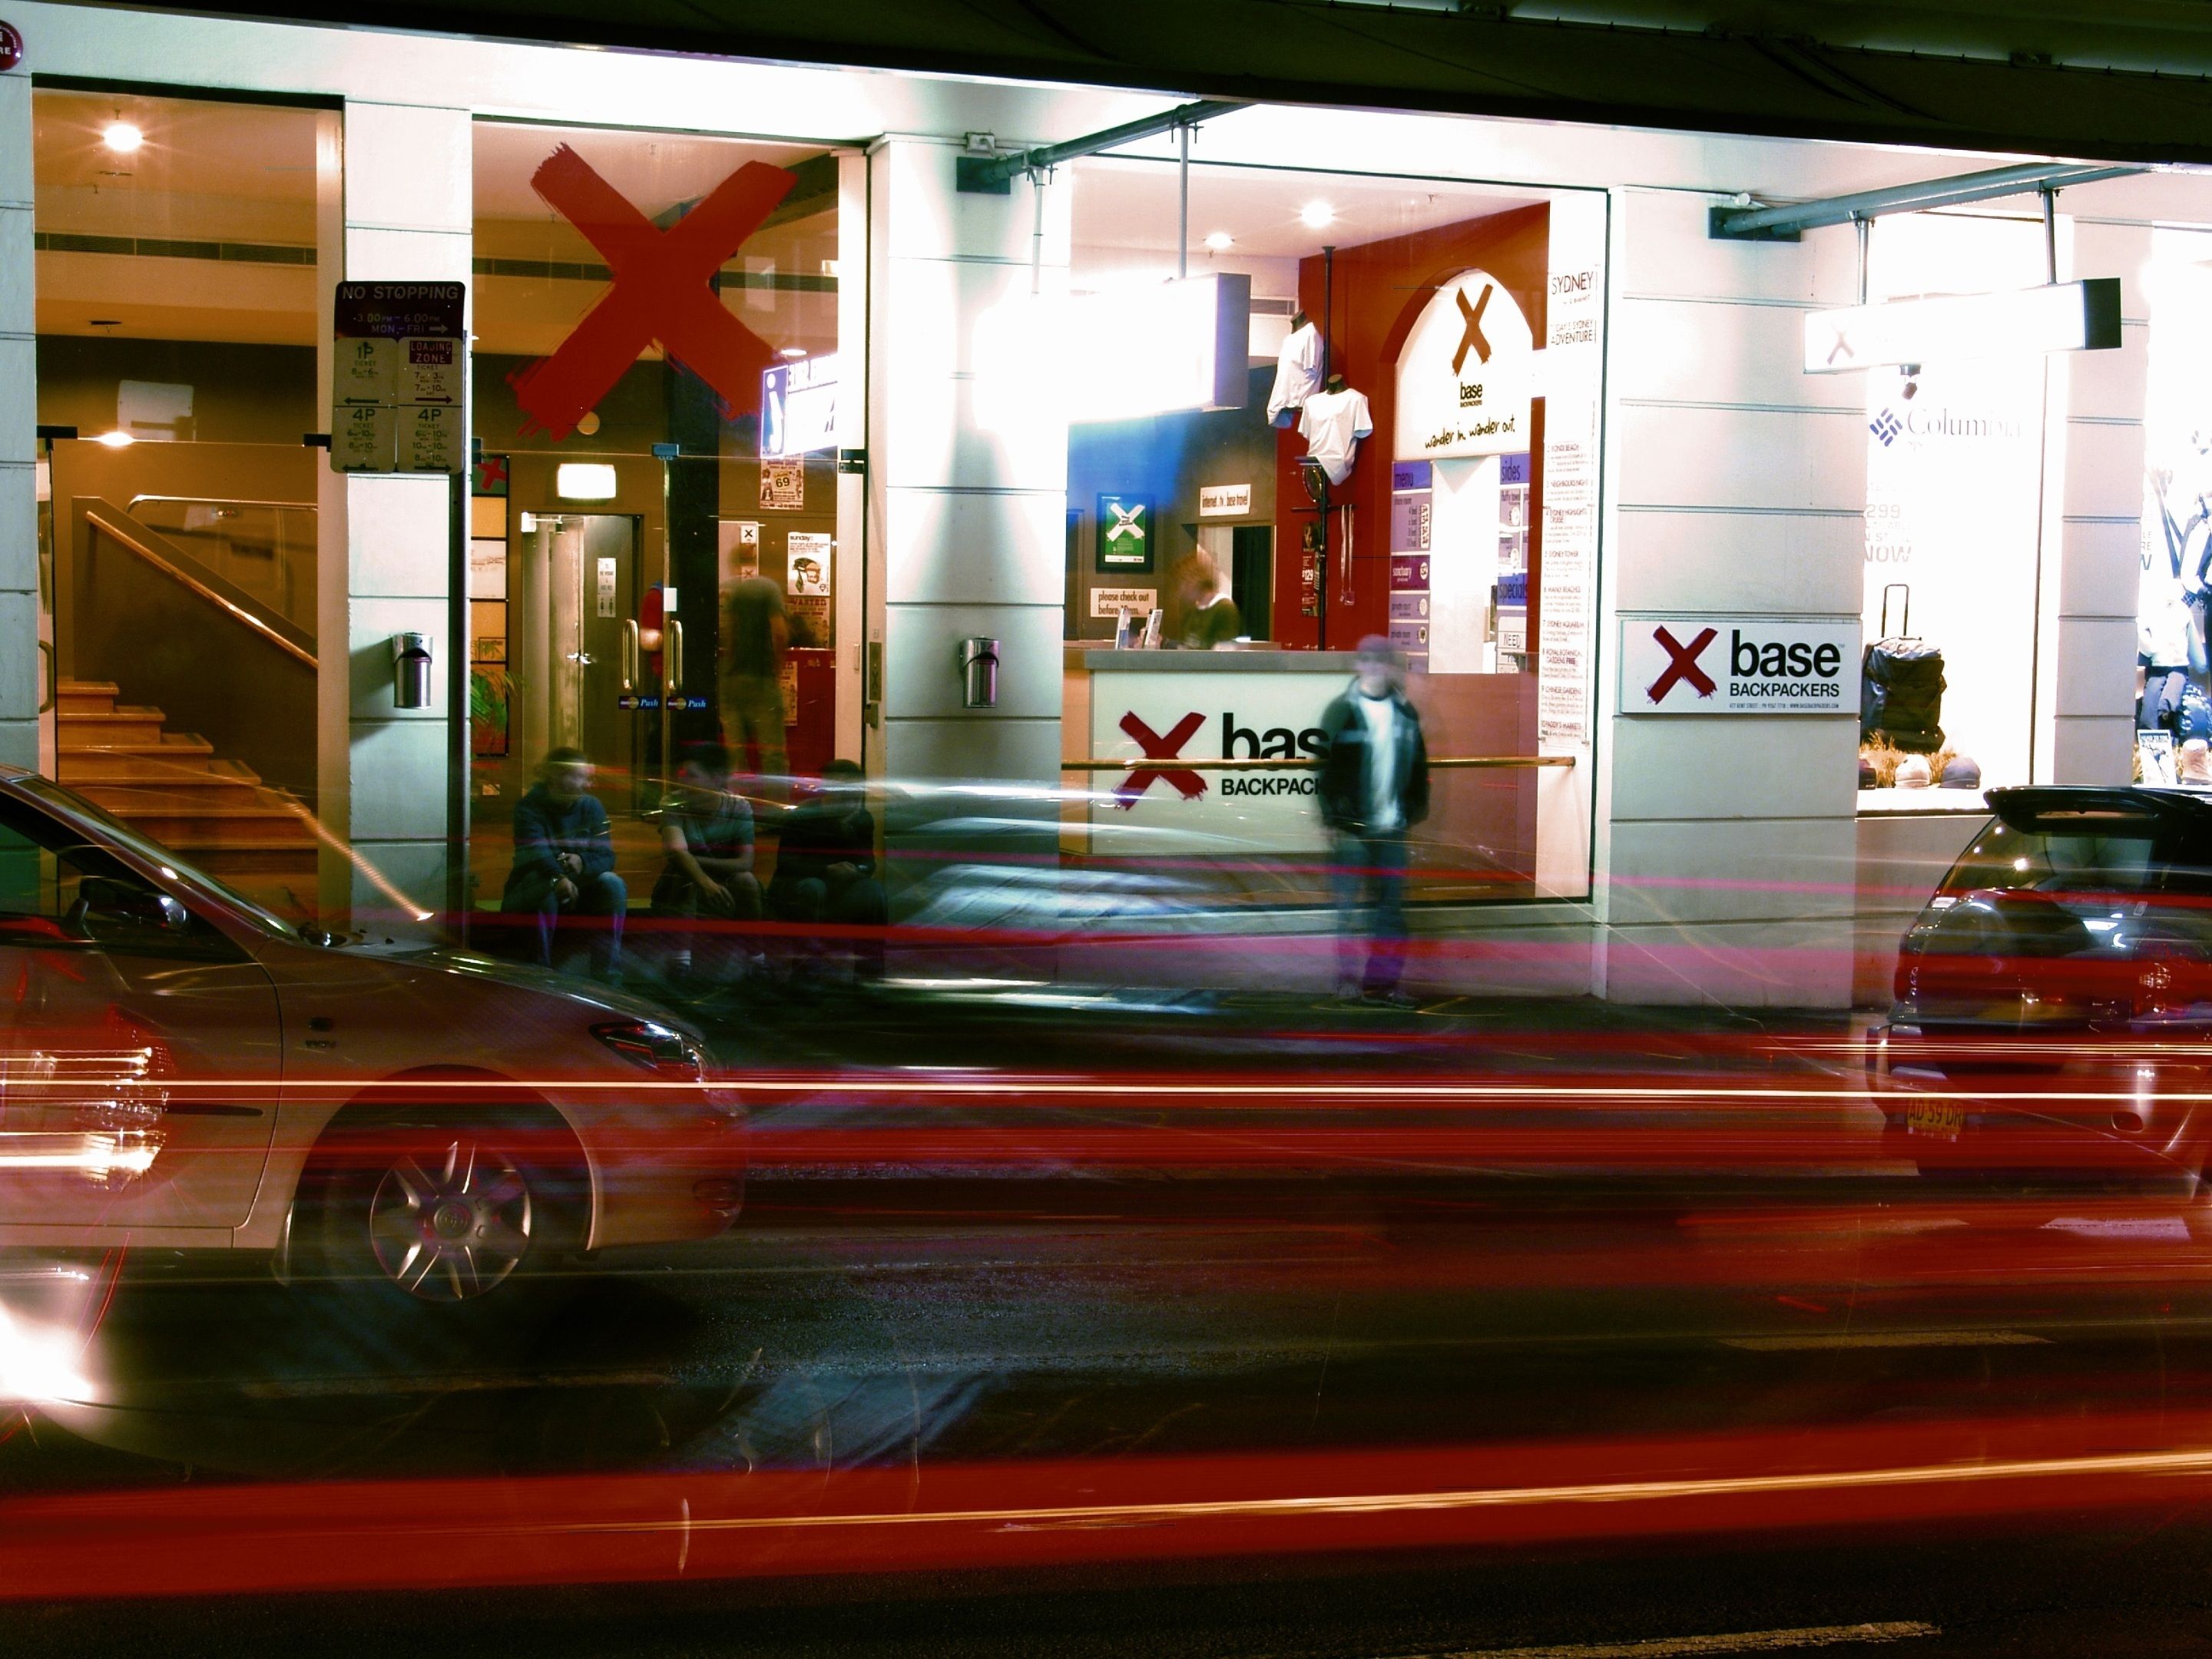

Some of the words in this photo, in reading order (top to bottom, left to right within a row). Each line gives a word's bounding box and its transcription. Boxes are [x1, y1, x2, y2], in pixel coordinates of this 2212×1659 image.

[1551, 271, 1594, 295] SYDNEY
[343, 286, 366, 300] NO
[373, 286, 459, 300] STOPPING
[372, 324, 395, 333] MON
[406, 324, 424, 333] FRI
[357, 345, 374, 359] 1P
[411, 342, 452, 351] LOADING
[416, 353, 446, 363] ZONE
[1460, 382, 1483, 399] base
[1460, 399, 1483, 408] BACKPACKERS
[353, 409, 376, 421] 4P
[418, 409, 442, 421] 4P
[1425, 426, 1454, 449] wander
[1469, 417, 1500, 437] wander
[1502, 456, 1521, 481] sides
[776, 477, 790, 488] 69
[1394, 472, 1414, 488] menu
[1202, 495, 1217, 508] internet
[1227, 492, 1236, 506] base
[1237, 490, 1248, 505] travel
[1865, 545, 1912, 562] NOW
[1392, 566, 1412, 580] sanctuary
[1098, 590, 1118, 603] please
[1120, 591, 1137, 601] check
[1138, 593, 1150, 601] out
[1498, 575, 1527, 604] specials
[1098, 604, 1118, 614] before
[1504, 634, 1522, 647] NEED
[1730, 629, 1841, 677] base
[1730, 683, 1839, 697] BACKPACKERS
[641, 698, 658, 707] Push
[1222, 712, 1331, 771] bas
